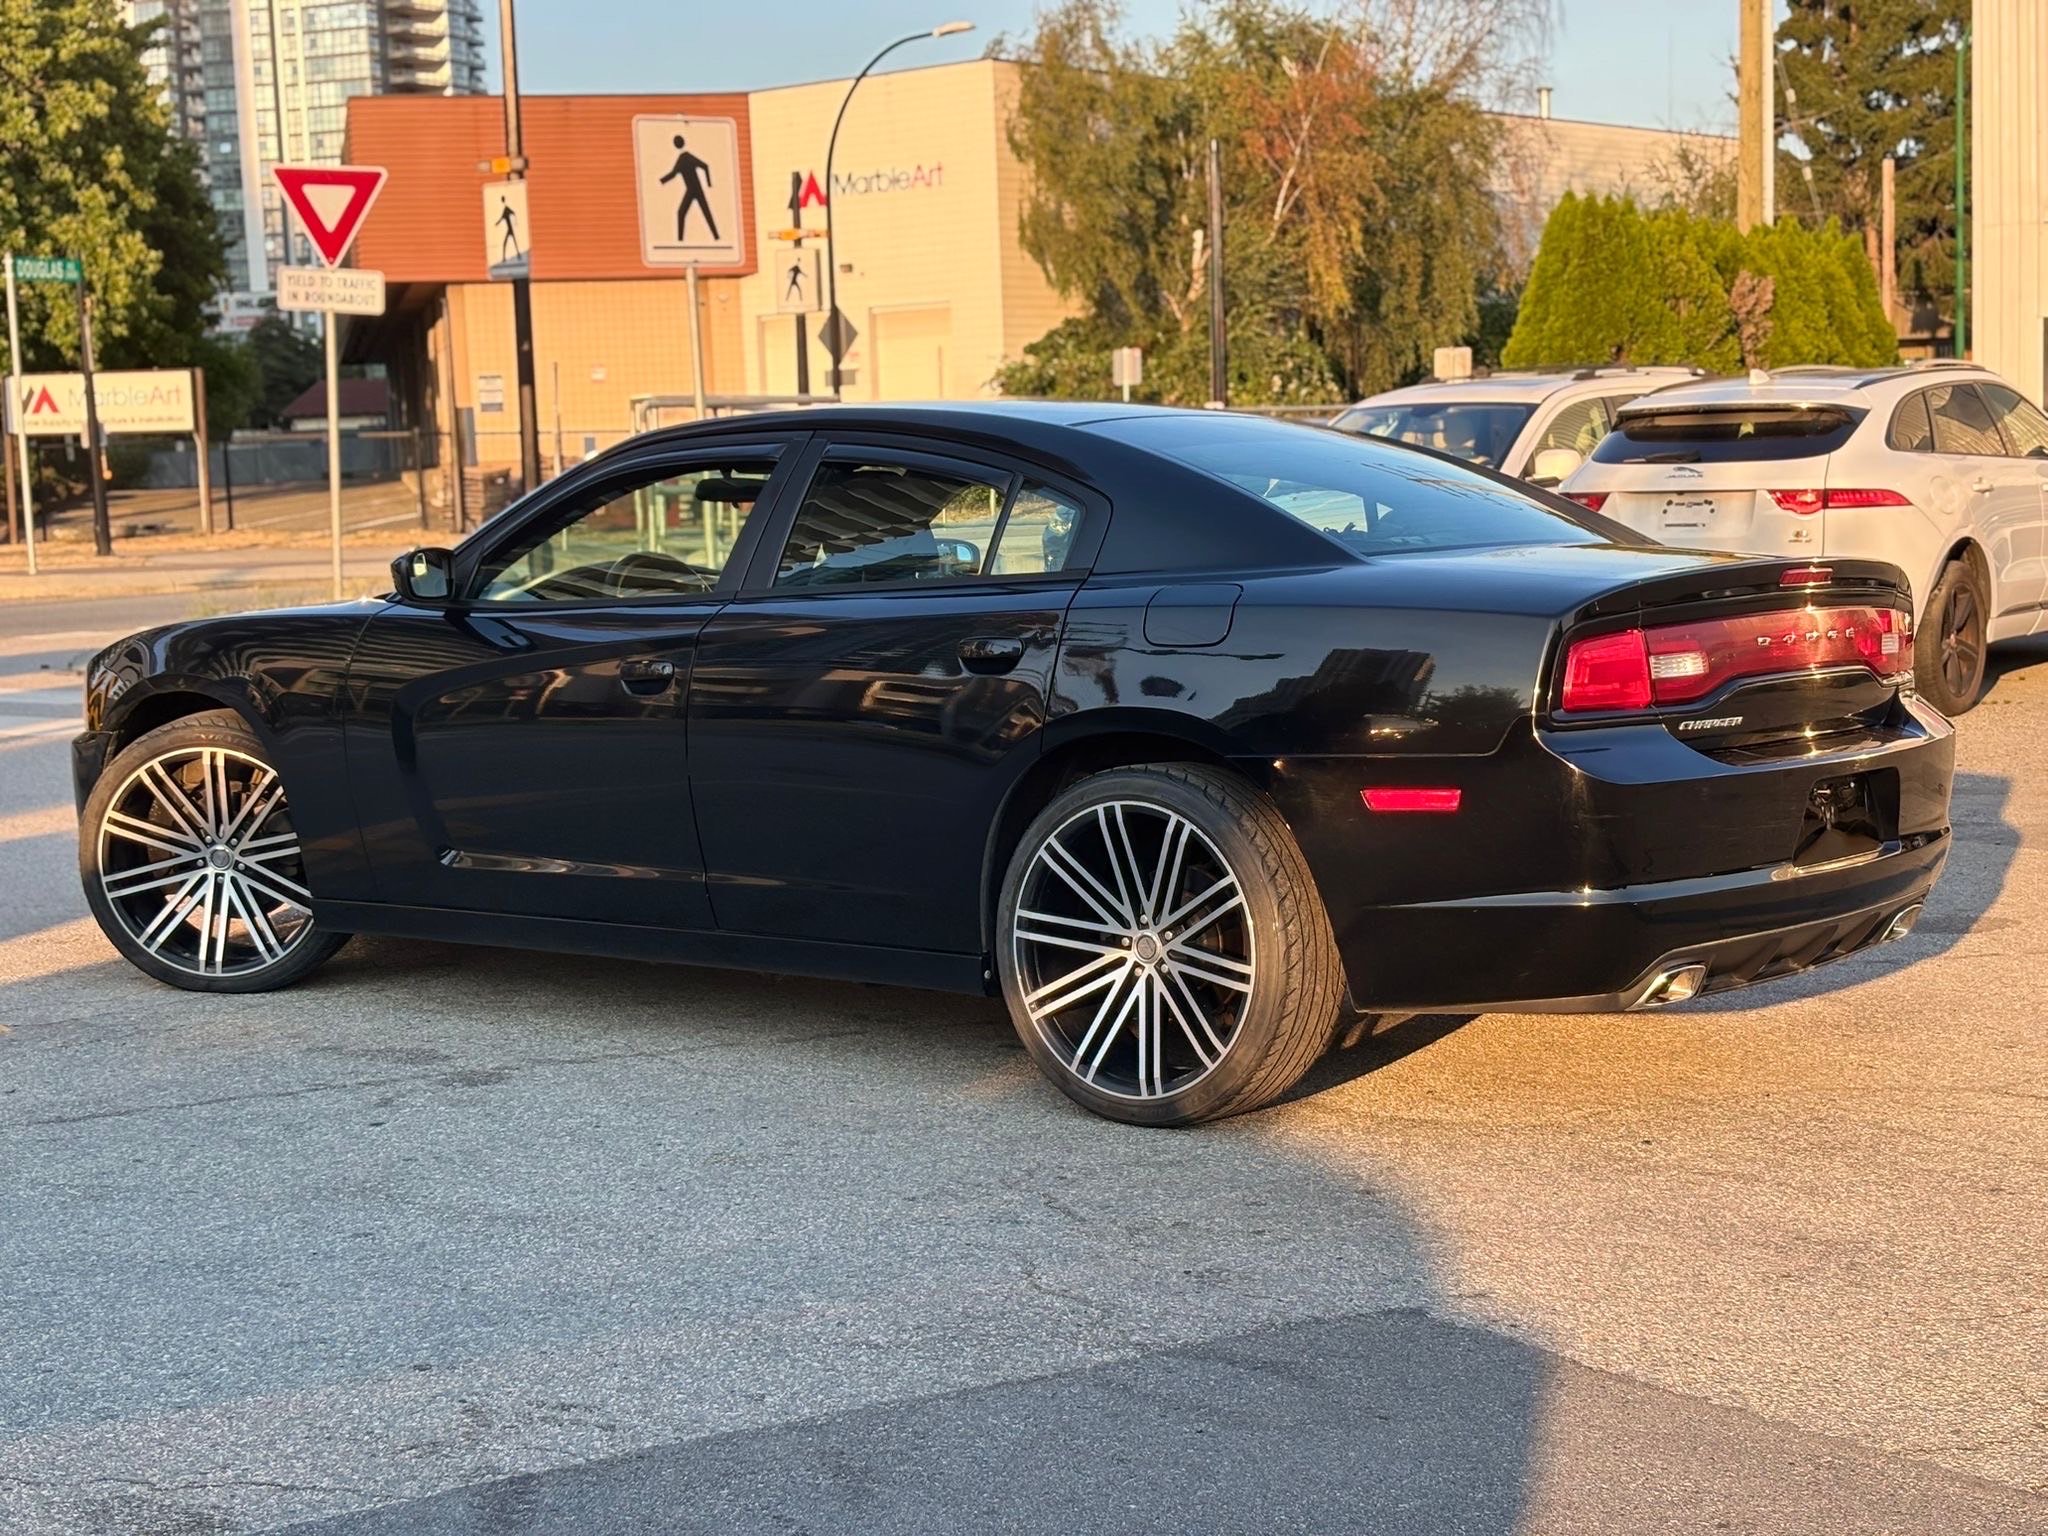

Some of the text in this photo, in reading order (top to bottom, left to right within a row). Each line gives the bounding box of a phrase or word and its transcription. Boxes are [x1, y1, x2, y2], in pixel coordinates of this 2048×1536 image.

[833, 161, 944, 196] MarbleArt
[16, 259, 64, 279] DOUGLAS
[286, 275, 377, 291] YIELD TO TRAFFIC
[287, 290, 377, 307] IN ROUNDABOUT
[1757, 626, 1856, 647] DODGE
[1678, 716, 1744, 731] CHARGER
